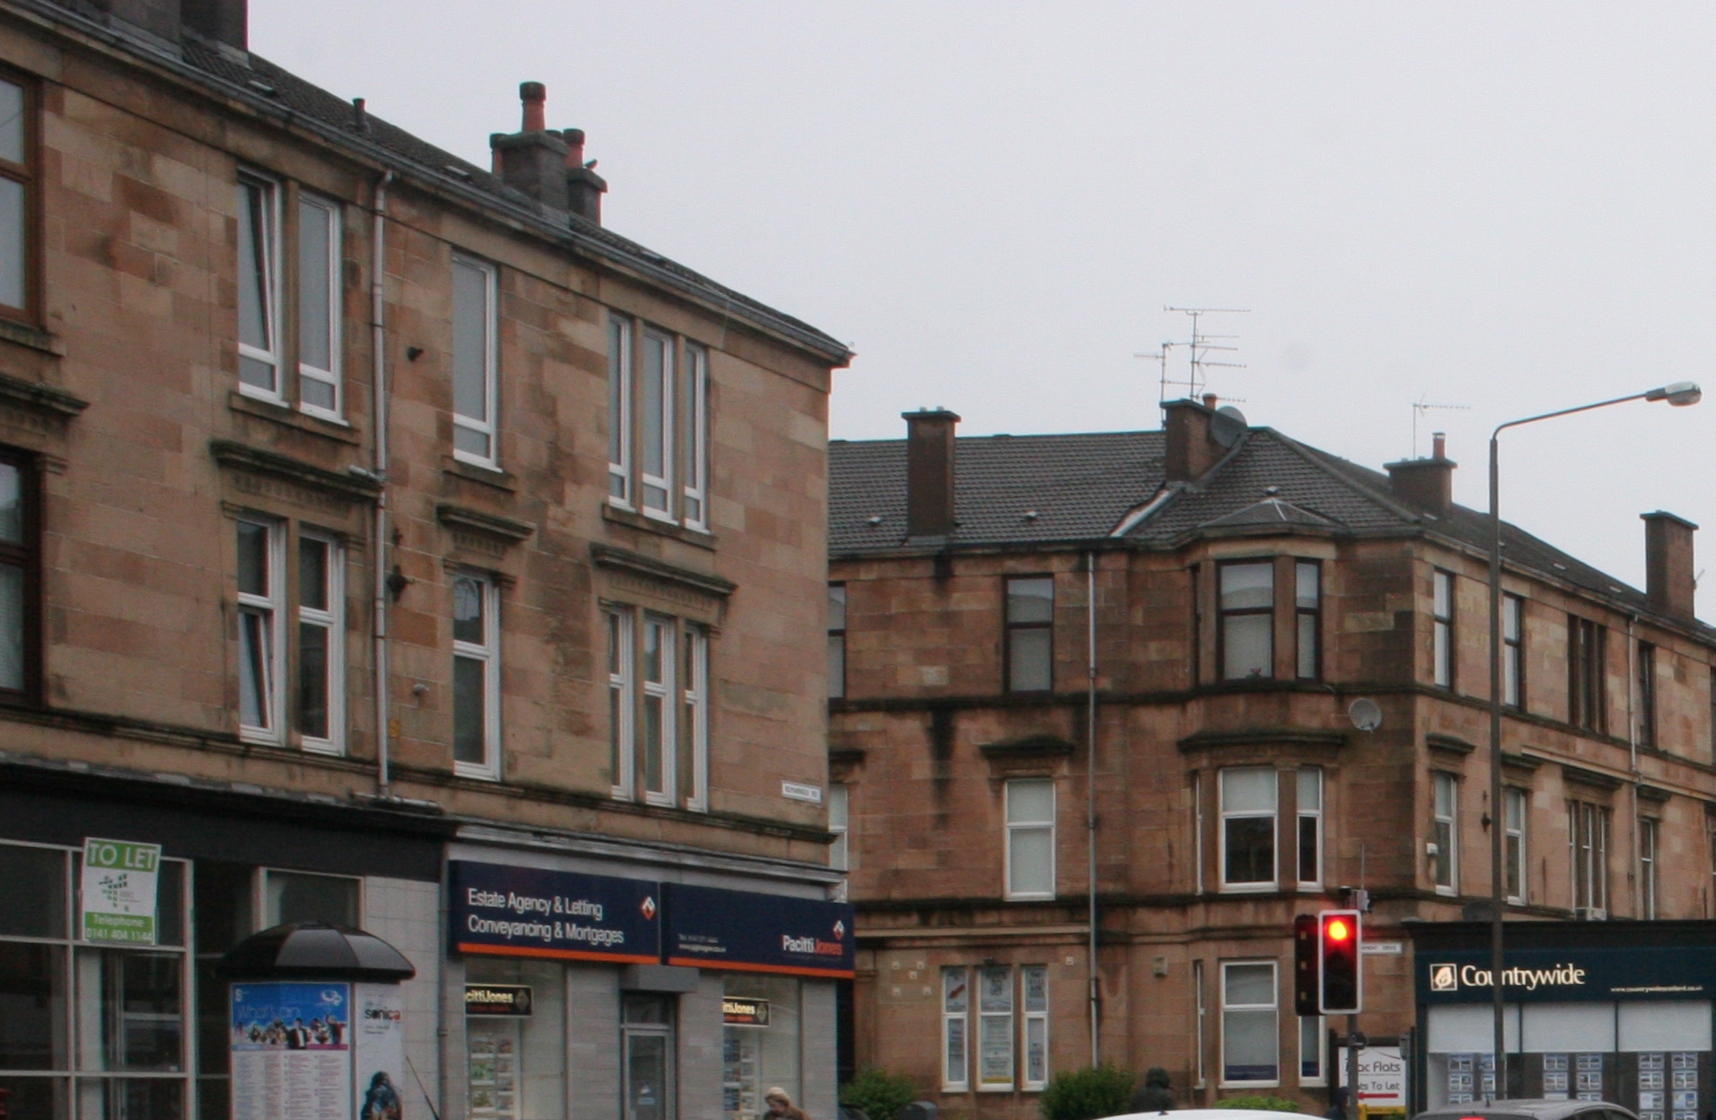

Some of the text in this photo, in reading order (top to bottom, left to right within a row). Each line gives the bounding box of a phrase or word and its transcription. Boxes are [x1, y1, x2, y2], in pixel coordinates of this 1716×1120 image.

[88, 843, 158, 869] TO LET
[467, 887, 604, 921] Estate Agency & Letting
[94, 914, 145, 928] Telephone
[468, 914, 625, 947] Conveyancing & Mortgages
[1373, 1061, 1401, 1072] Flats
[1371, 1082, 1382, 1090] To
[1386, 1082, 1400, 1090] Let
